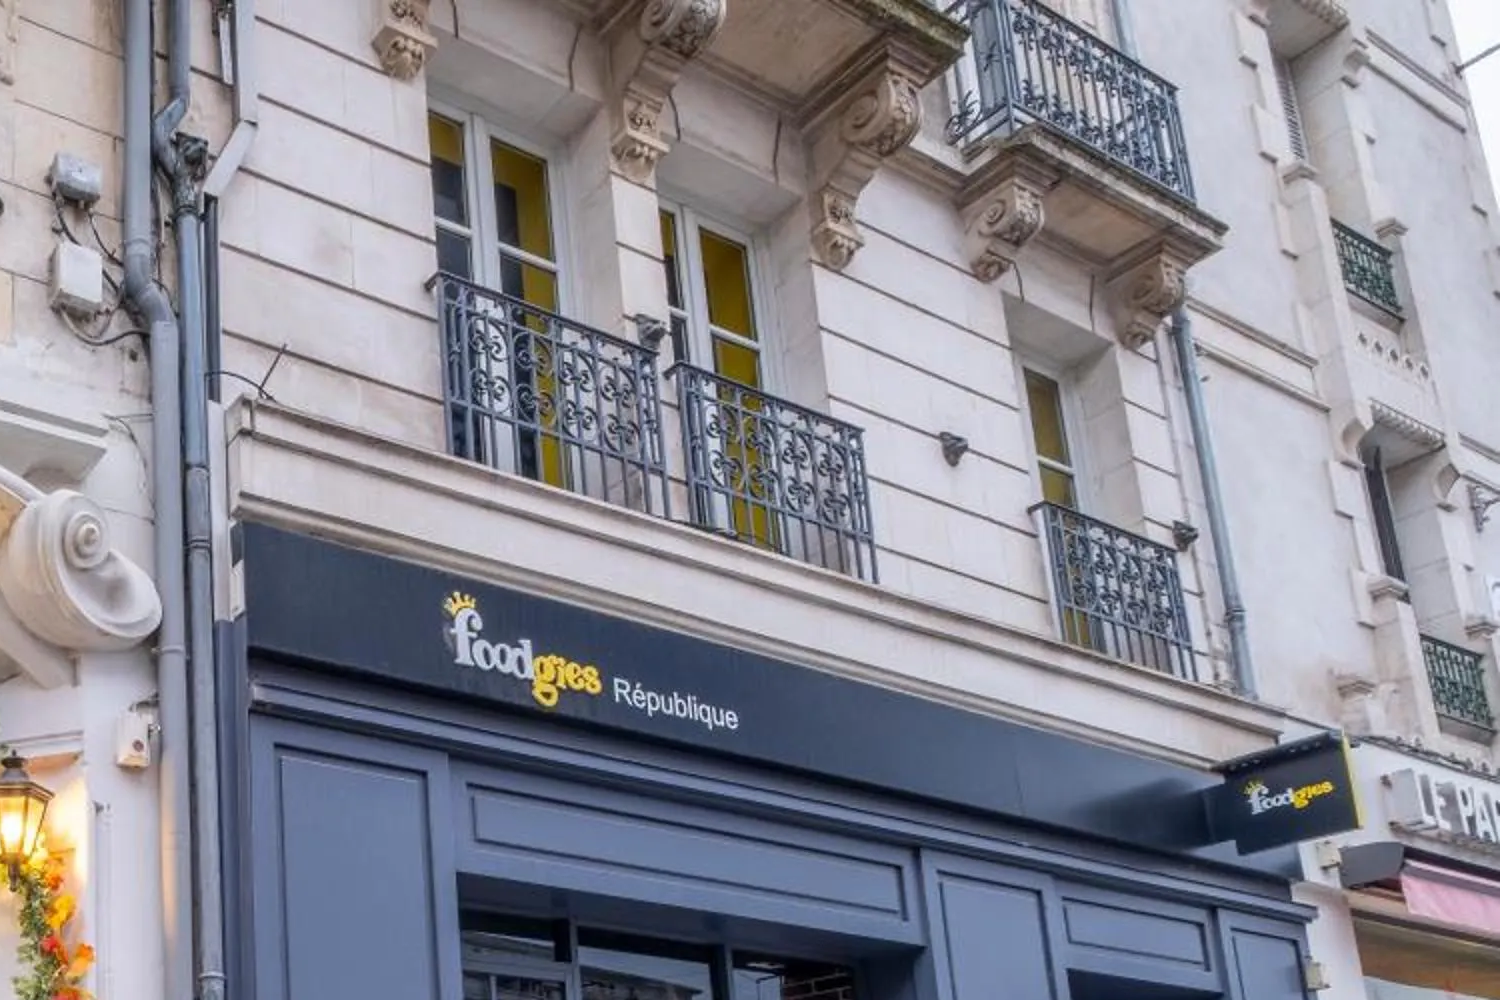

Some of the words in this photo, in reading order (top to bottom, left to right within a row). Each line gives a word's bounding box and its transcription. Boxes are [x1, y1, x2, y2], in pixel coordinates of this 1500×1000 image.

[450, 606, 602, 706] foodgies
[613, 677, 739, 731] République
[1247, 781, 1334, 815] foodgies
[1414, 767, 1452, 831] LE
